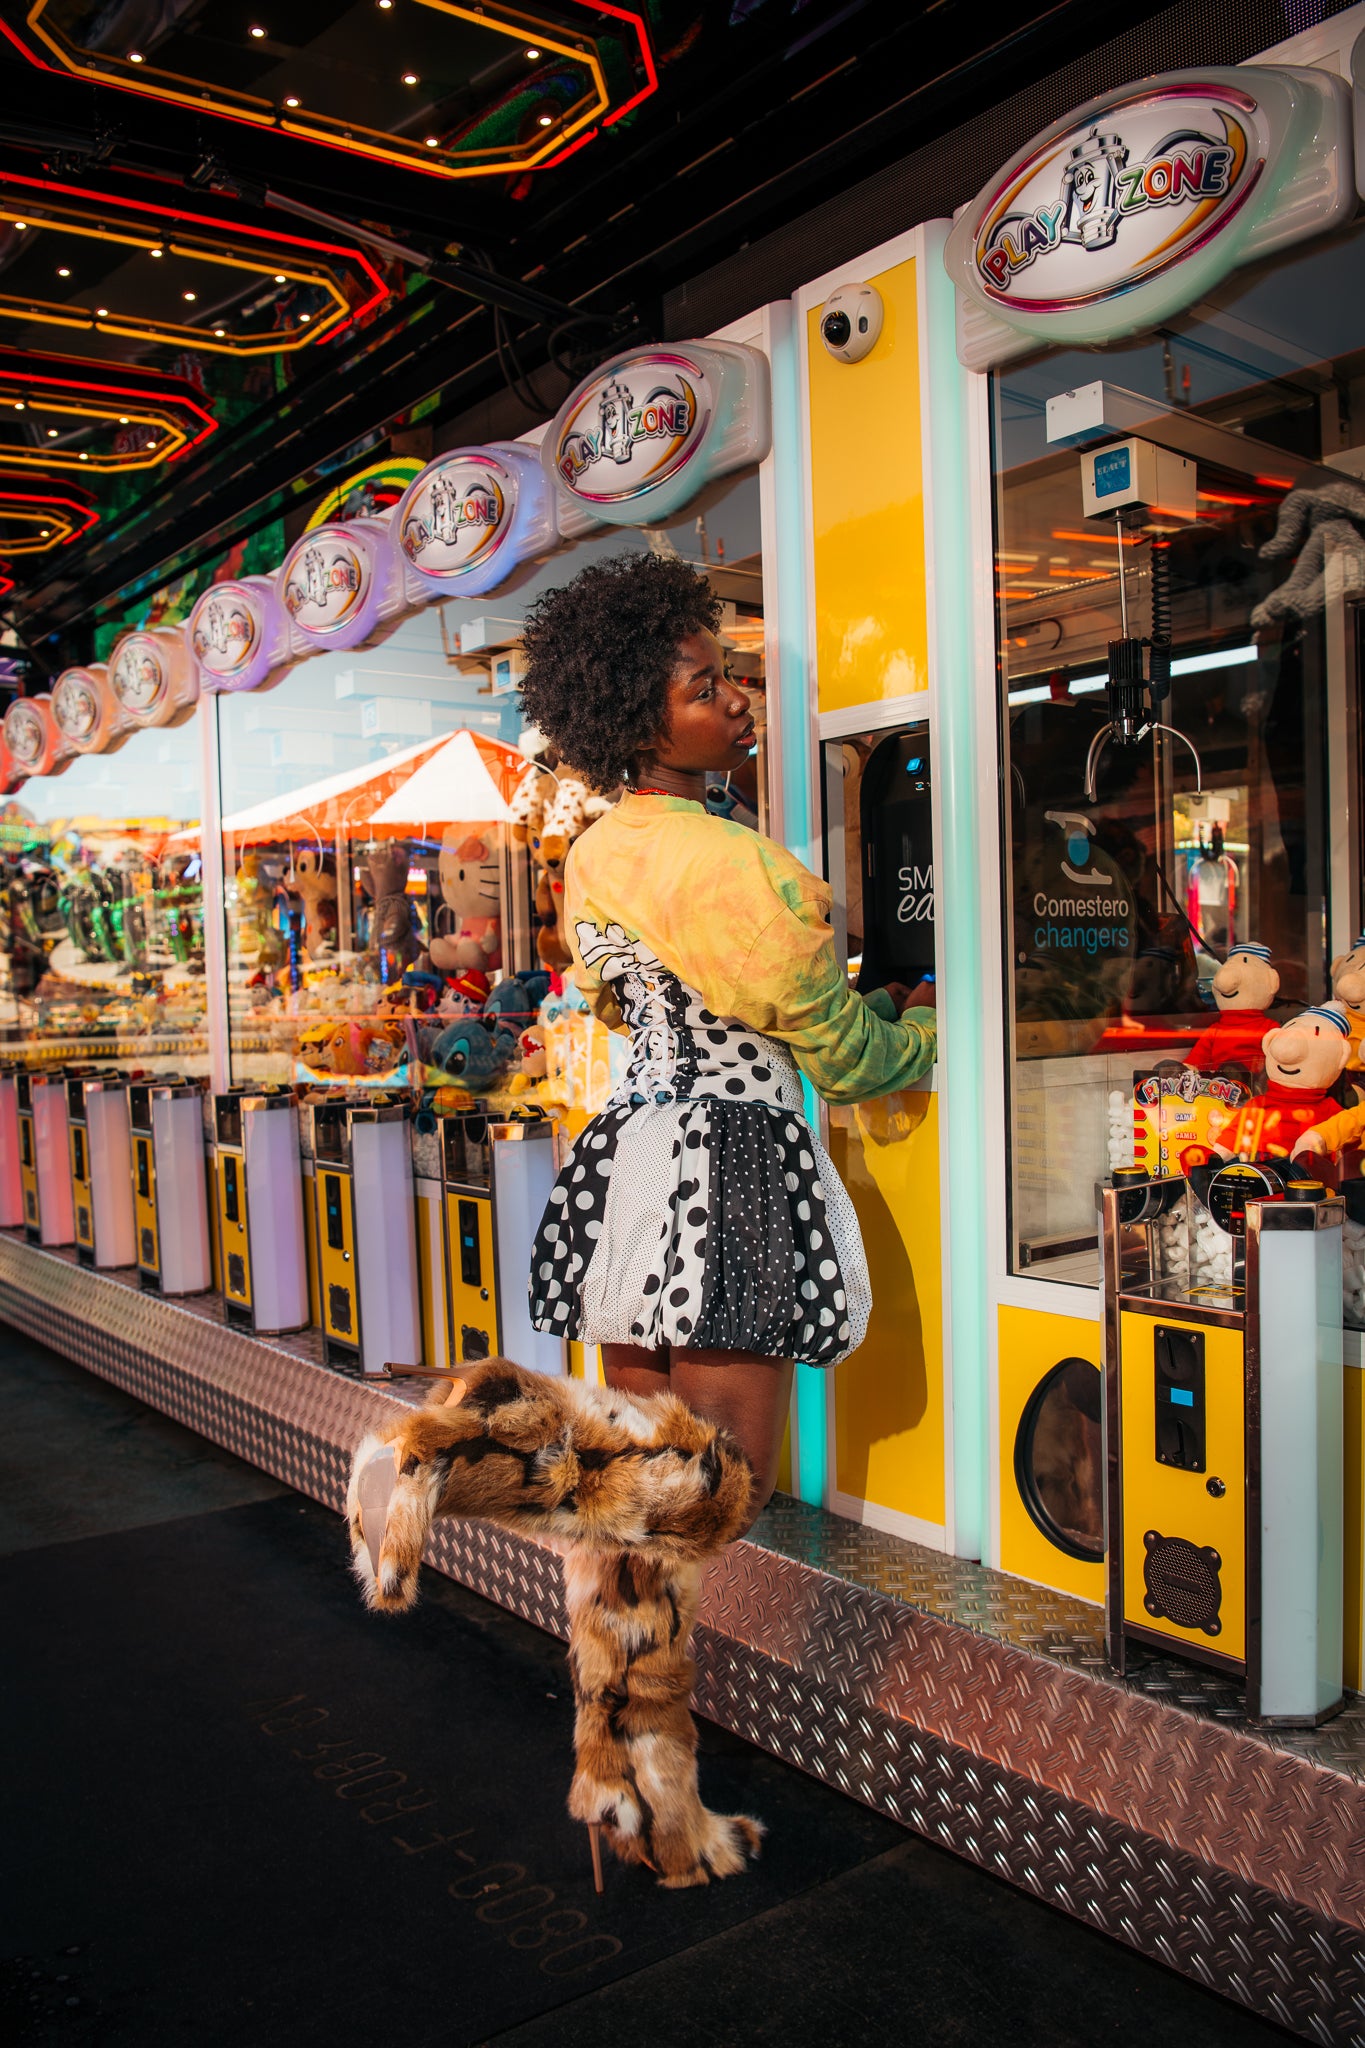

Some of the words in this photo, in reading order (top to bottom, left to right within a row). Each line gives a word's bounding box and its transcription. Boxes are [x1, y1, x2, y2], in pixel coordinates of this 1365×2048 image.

[982, 202, 1066, 287] PLAY
[1119, 148, 1230, 210] ZONE
[559, 428, 601, 484] PLAY
[629, 402, 688, 439] ZONE
[404, 516, 434, 559] PLAY
[454, 497, 497, 525] ZONE
[322, 566, 357, 590] ZONE
[1033, 892, 1130, 918] Comestero
[1034, 921, 1130, 955] changers
[1144, 1080, 1178, 1100] PLAY
[1201, 1080, 1239, 1102] ZONE
[1161, 1129, 1169, 1141] 3
[1175, 1132, 1197, 1141] GAMES
[1161, 1147, 1169, 1161] 8
